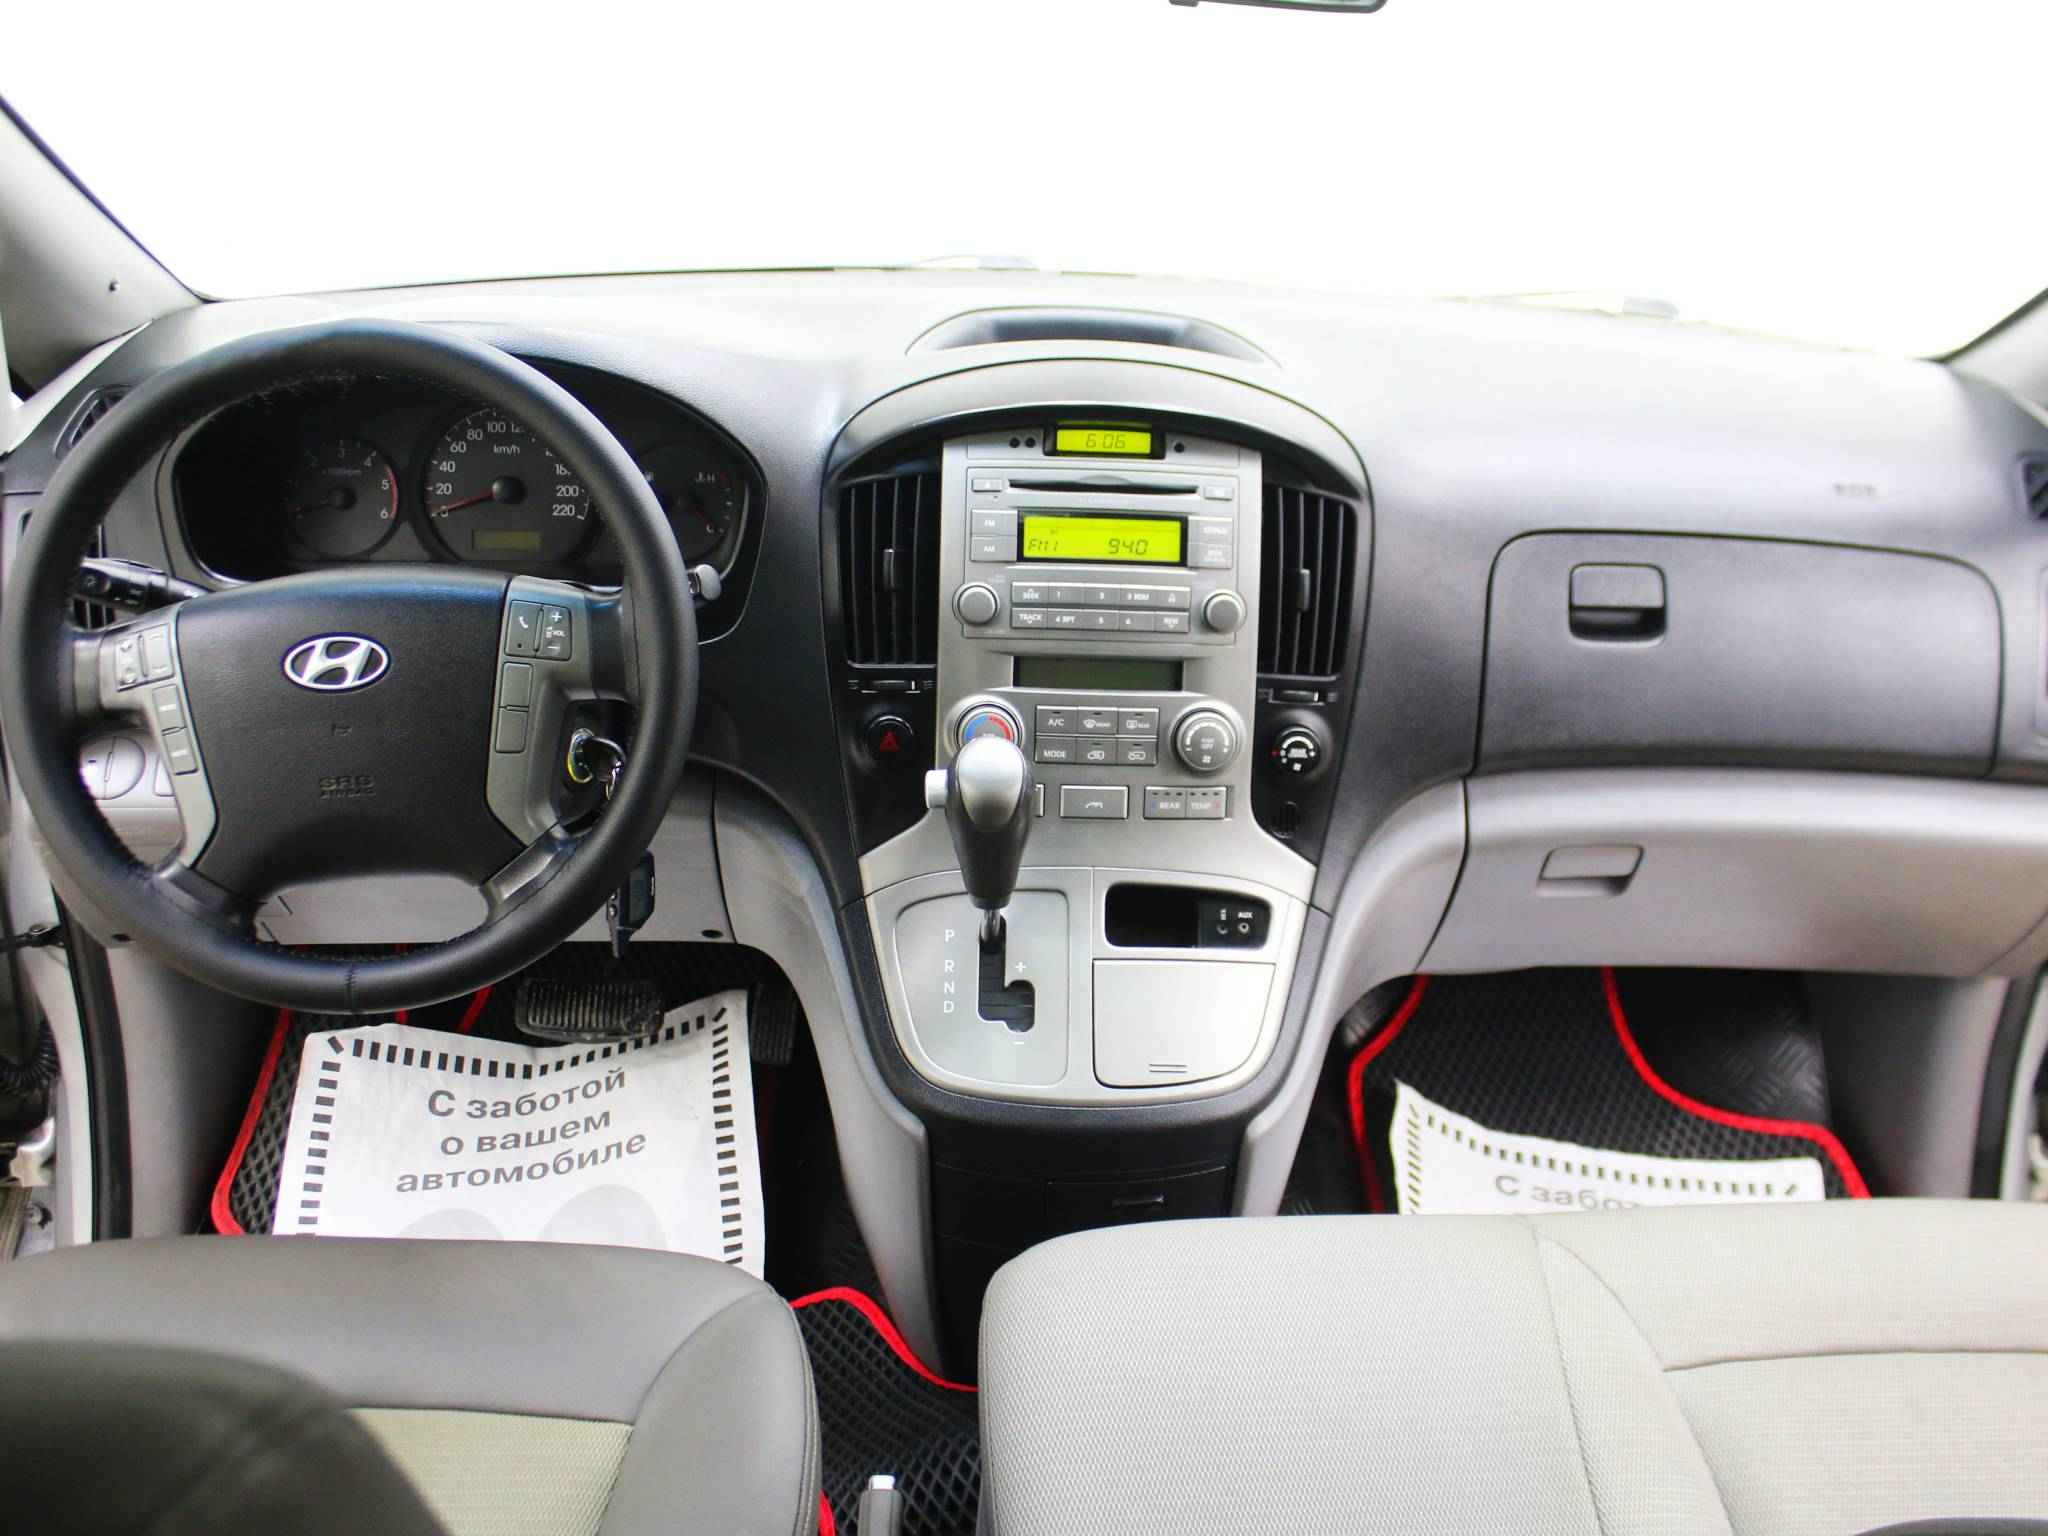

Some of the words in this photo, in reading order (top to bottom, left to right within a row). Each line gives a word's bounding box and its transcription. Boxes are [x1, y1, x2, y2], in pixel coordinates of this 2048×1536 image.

[487, 421, 506, 433] 100
[466, 429, 483, 441] 80
[450, 441, 467, 453] 60
[493, 444, 521, 455] km/h
[439, 460, 456, 473] 40
[381, 479, 390, 490] 5
[435, 483, 453, 495] 20
[556, 485, 579, 497] 200
[380, 508, 389, 519] 6
[552, 504, 575, 517] 220
[1047, 718, 1065, 728] A/C
[1043, 749, 1067, 759] MODE
[944, 929, 955, 943] P
[944, 959, 955, 973] R
[943, 981, 954, 995] N
[943, 1000, 955, 1013] D
[428, 1090, 456, 1117] С
[466, 1067, 625, 1119] заботой
[440, 1136, 464, 1155] о
[476, 1111, 611, 1153] вашем
[396, 1133, 647, 1193] автомобиле
